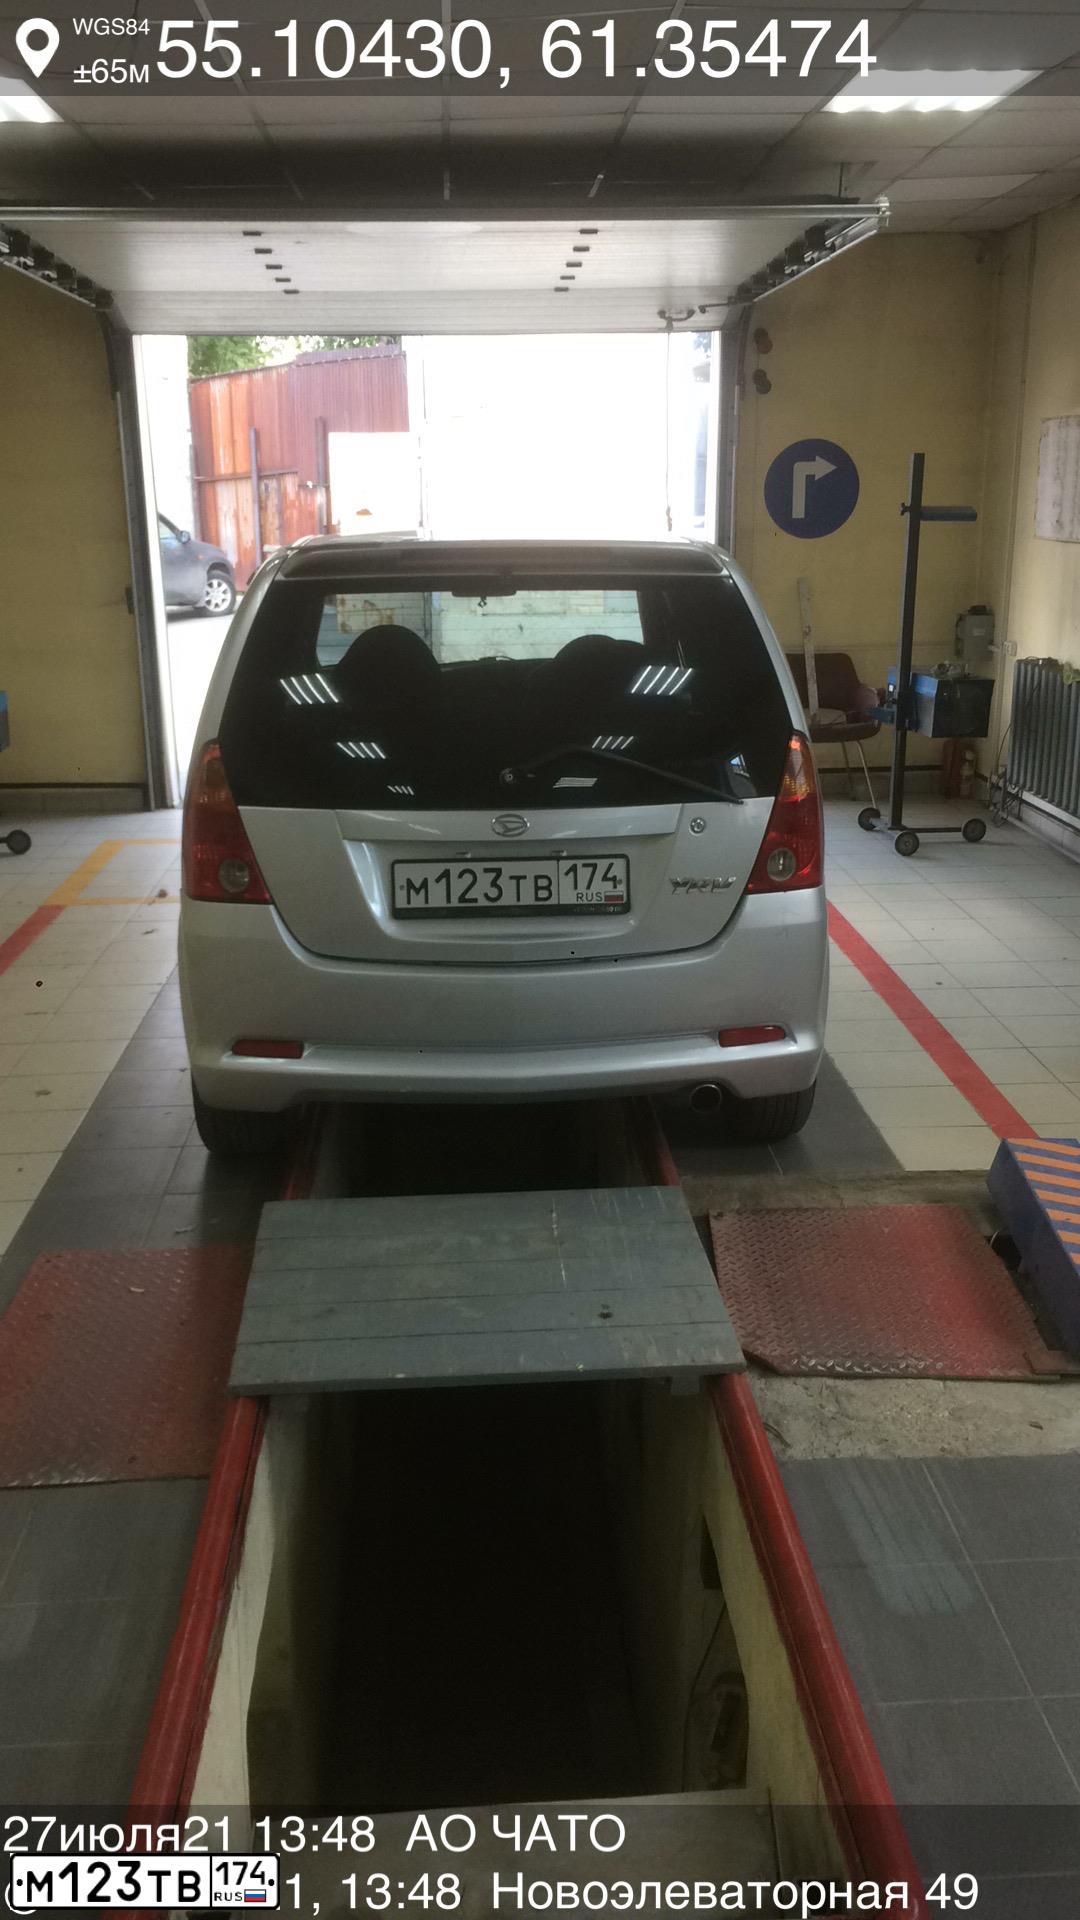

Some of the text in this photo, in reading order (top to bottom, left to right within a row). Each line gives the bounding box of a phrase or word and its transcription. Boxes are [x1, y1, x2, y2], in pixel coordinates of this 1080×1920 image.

[406, 862, 618, 905] М123ТВ 174
[576, 892, 603, 902] RUS
